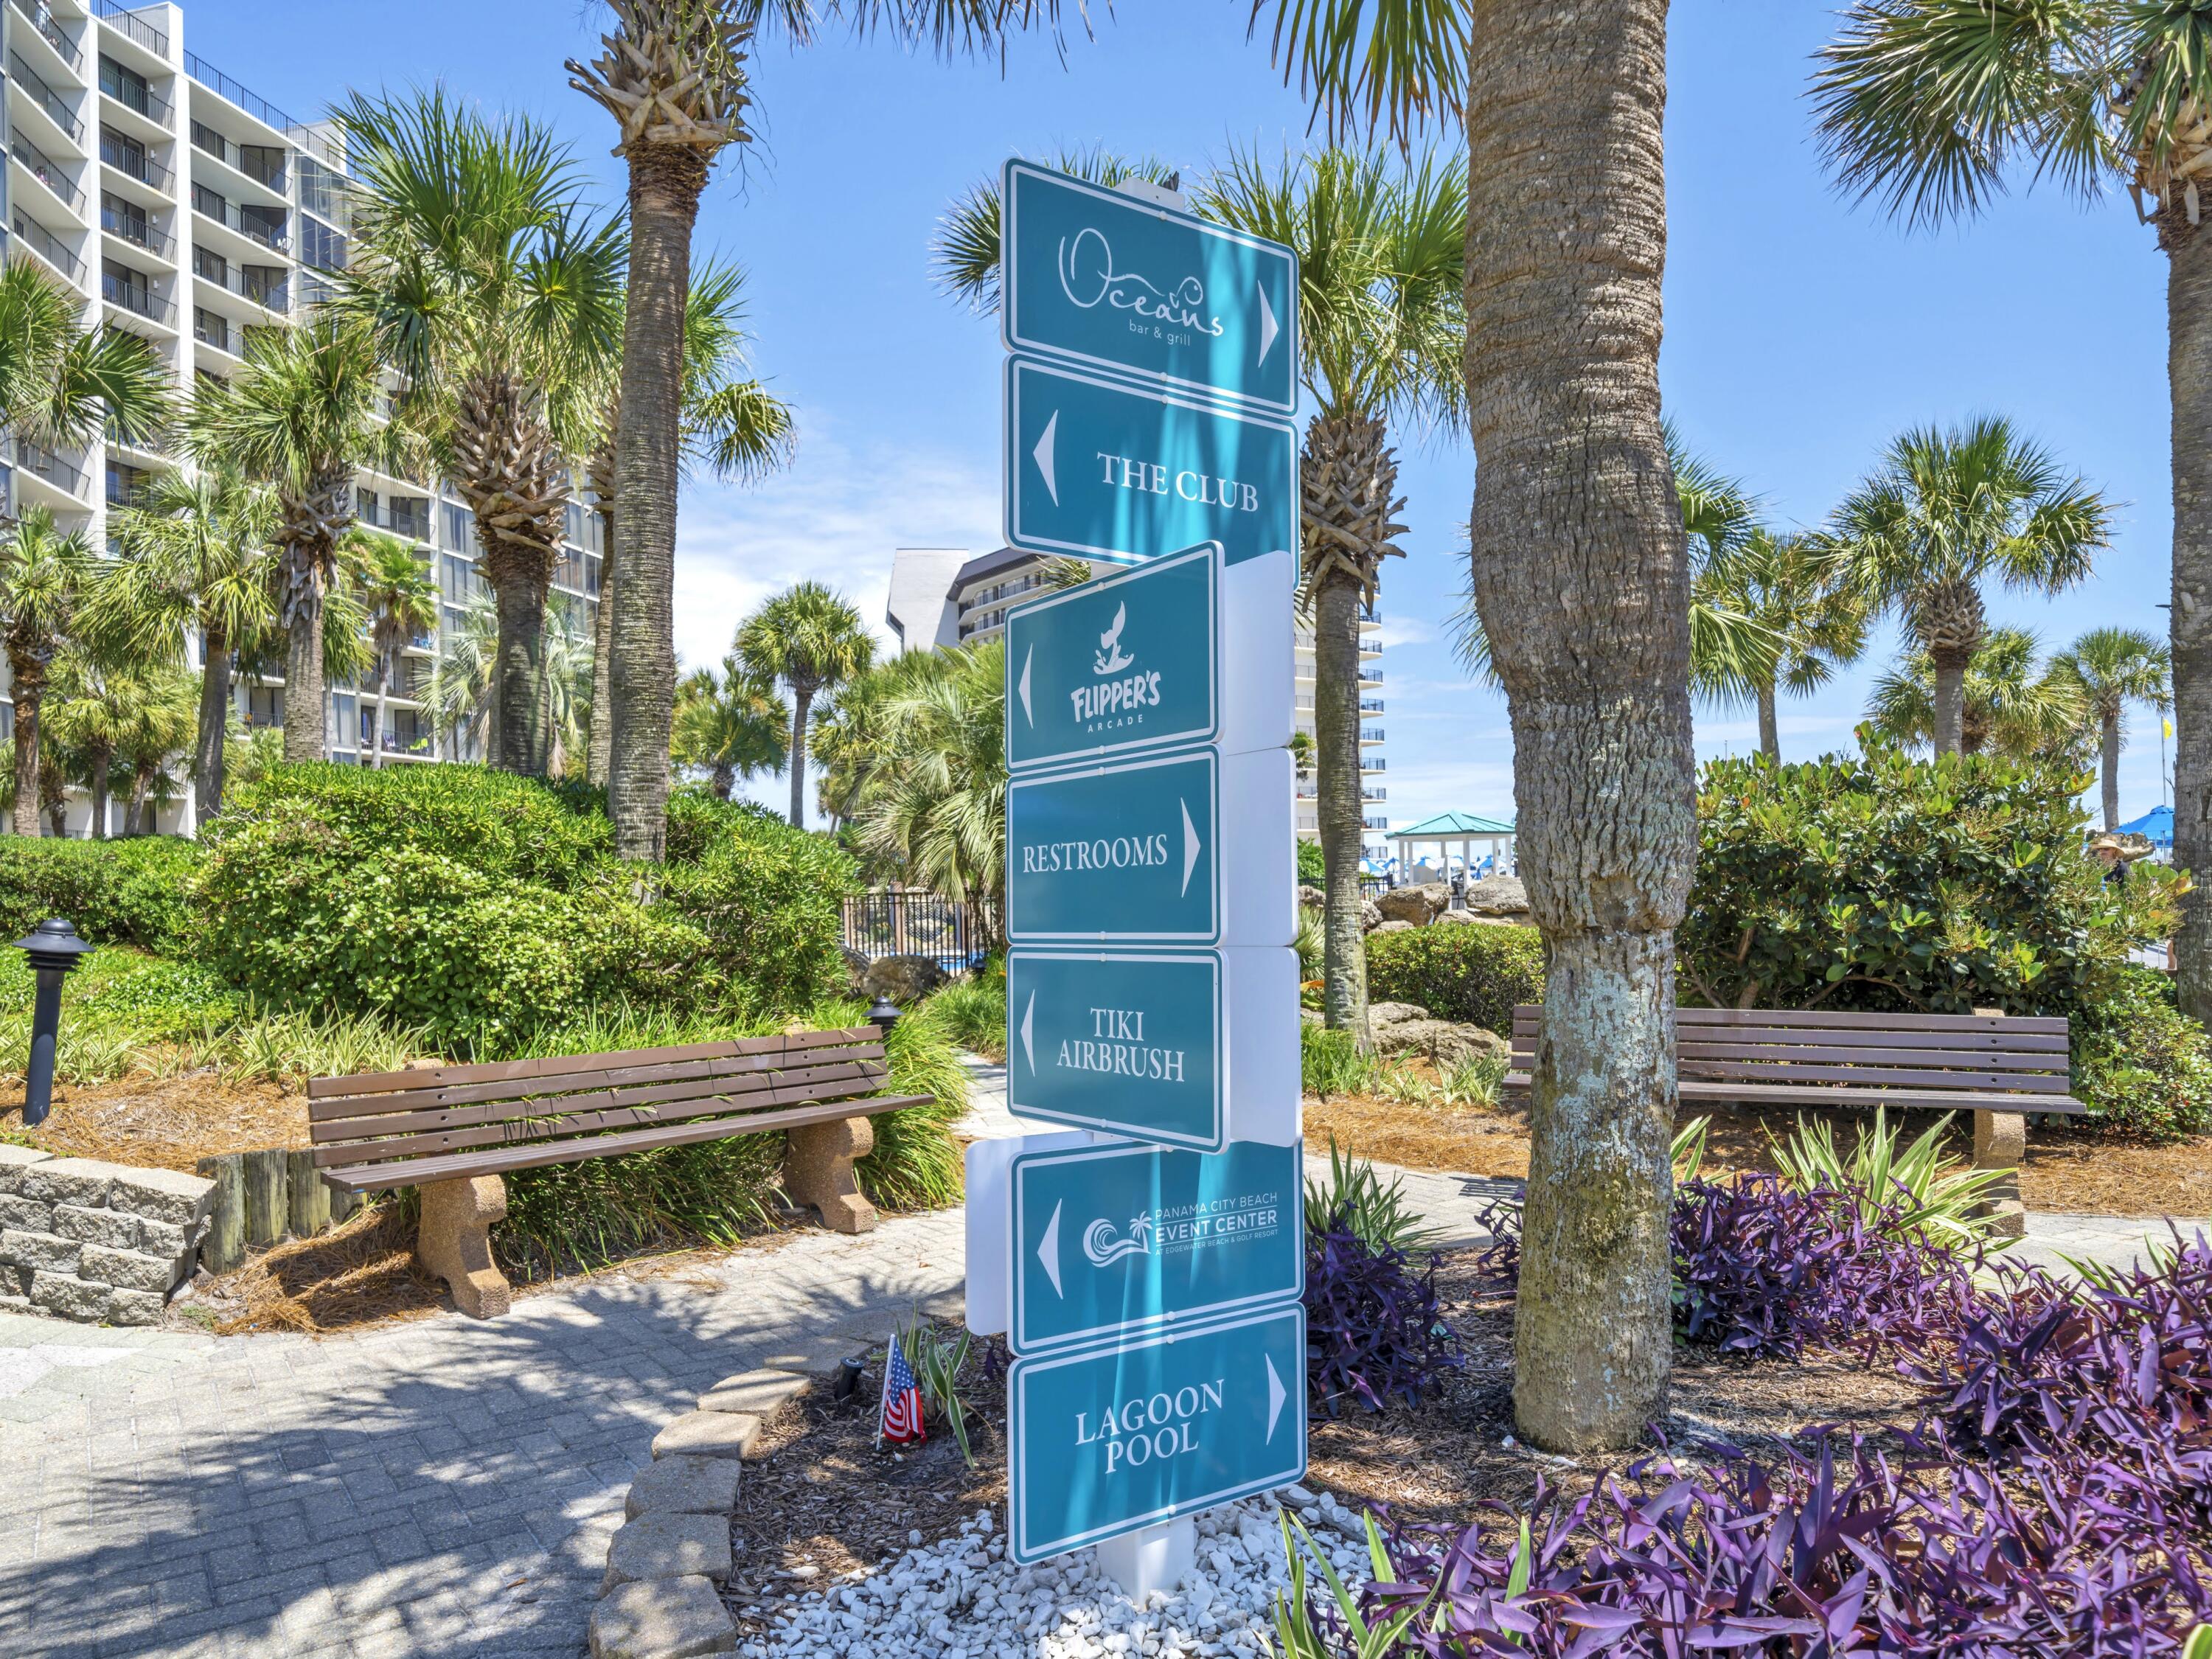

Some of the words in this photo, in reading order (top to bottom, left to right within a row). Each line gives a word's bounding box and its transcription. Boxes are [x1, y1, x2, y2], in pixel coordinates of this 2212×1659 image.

[1059, 228, 1224, 336] Oceans
[1129, 319, 1149, 335] bar
[1154, 327, 1162, 339] &
[1167, 333, 1190, 347] grill
[1096, 451, 1169, 495] THE
[1175, 471, 1259, 512] CLUB
[1071, 669, 1161, 723] FLIPPER'S
[1088, 714, 1143, 733] ARCADE
[1023, 834, 1168, 873] RESTROOMS
[1090, 1007, 1144, 1041] TIKI
[1056, 1038, 1185, 1082] AIRBRUSH
[1155, 1203, 1207, 1221] PANAMA
[1211, 1197, 1236, 1211] CITY
[1240, 1192, 1277, 1208] BEACH
[1156, 1220, 1211, 1243] EVENT
[1216, 1209, 1277, 1233] CENTER
[1155, 1248, 1164, 1256] AT
[1166, 1241, 1206, 1254] EDGEWATER
[1208, 1238, 1229, 1247] BEACH
[1237, 1234, 1253, 1242] GOLF
[1254, 1229, 1279, 1239] RESORT
[1075, 1379, 1225, 1446] LAGOON
[1105, 1422, 1199, 1474] POOL
